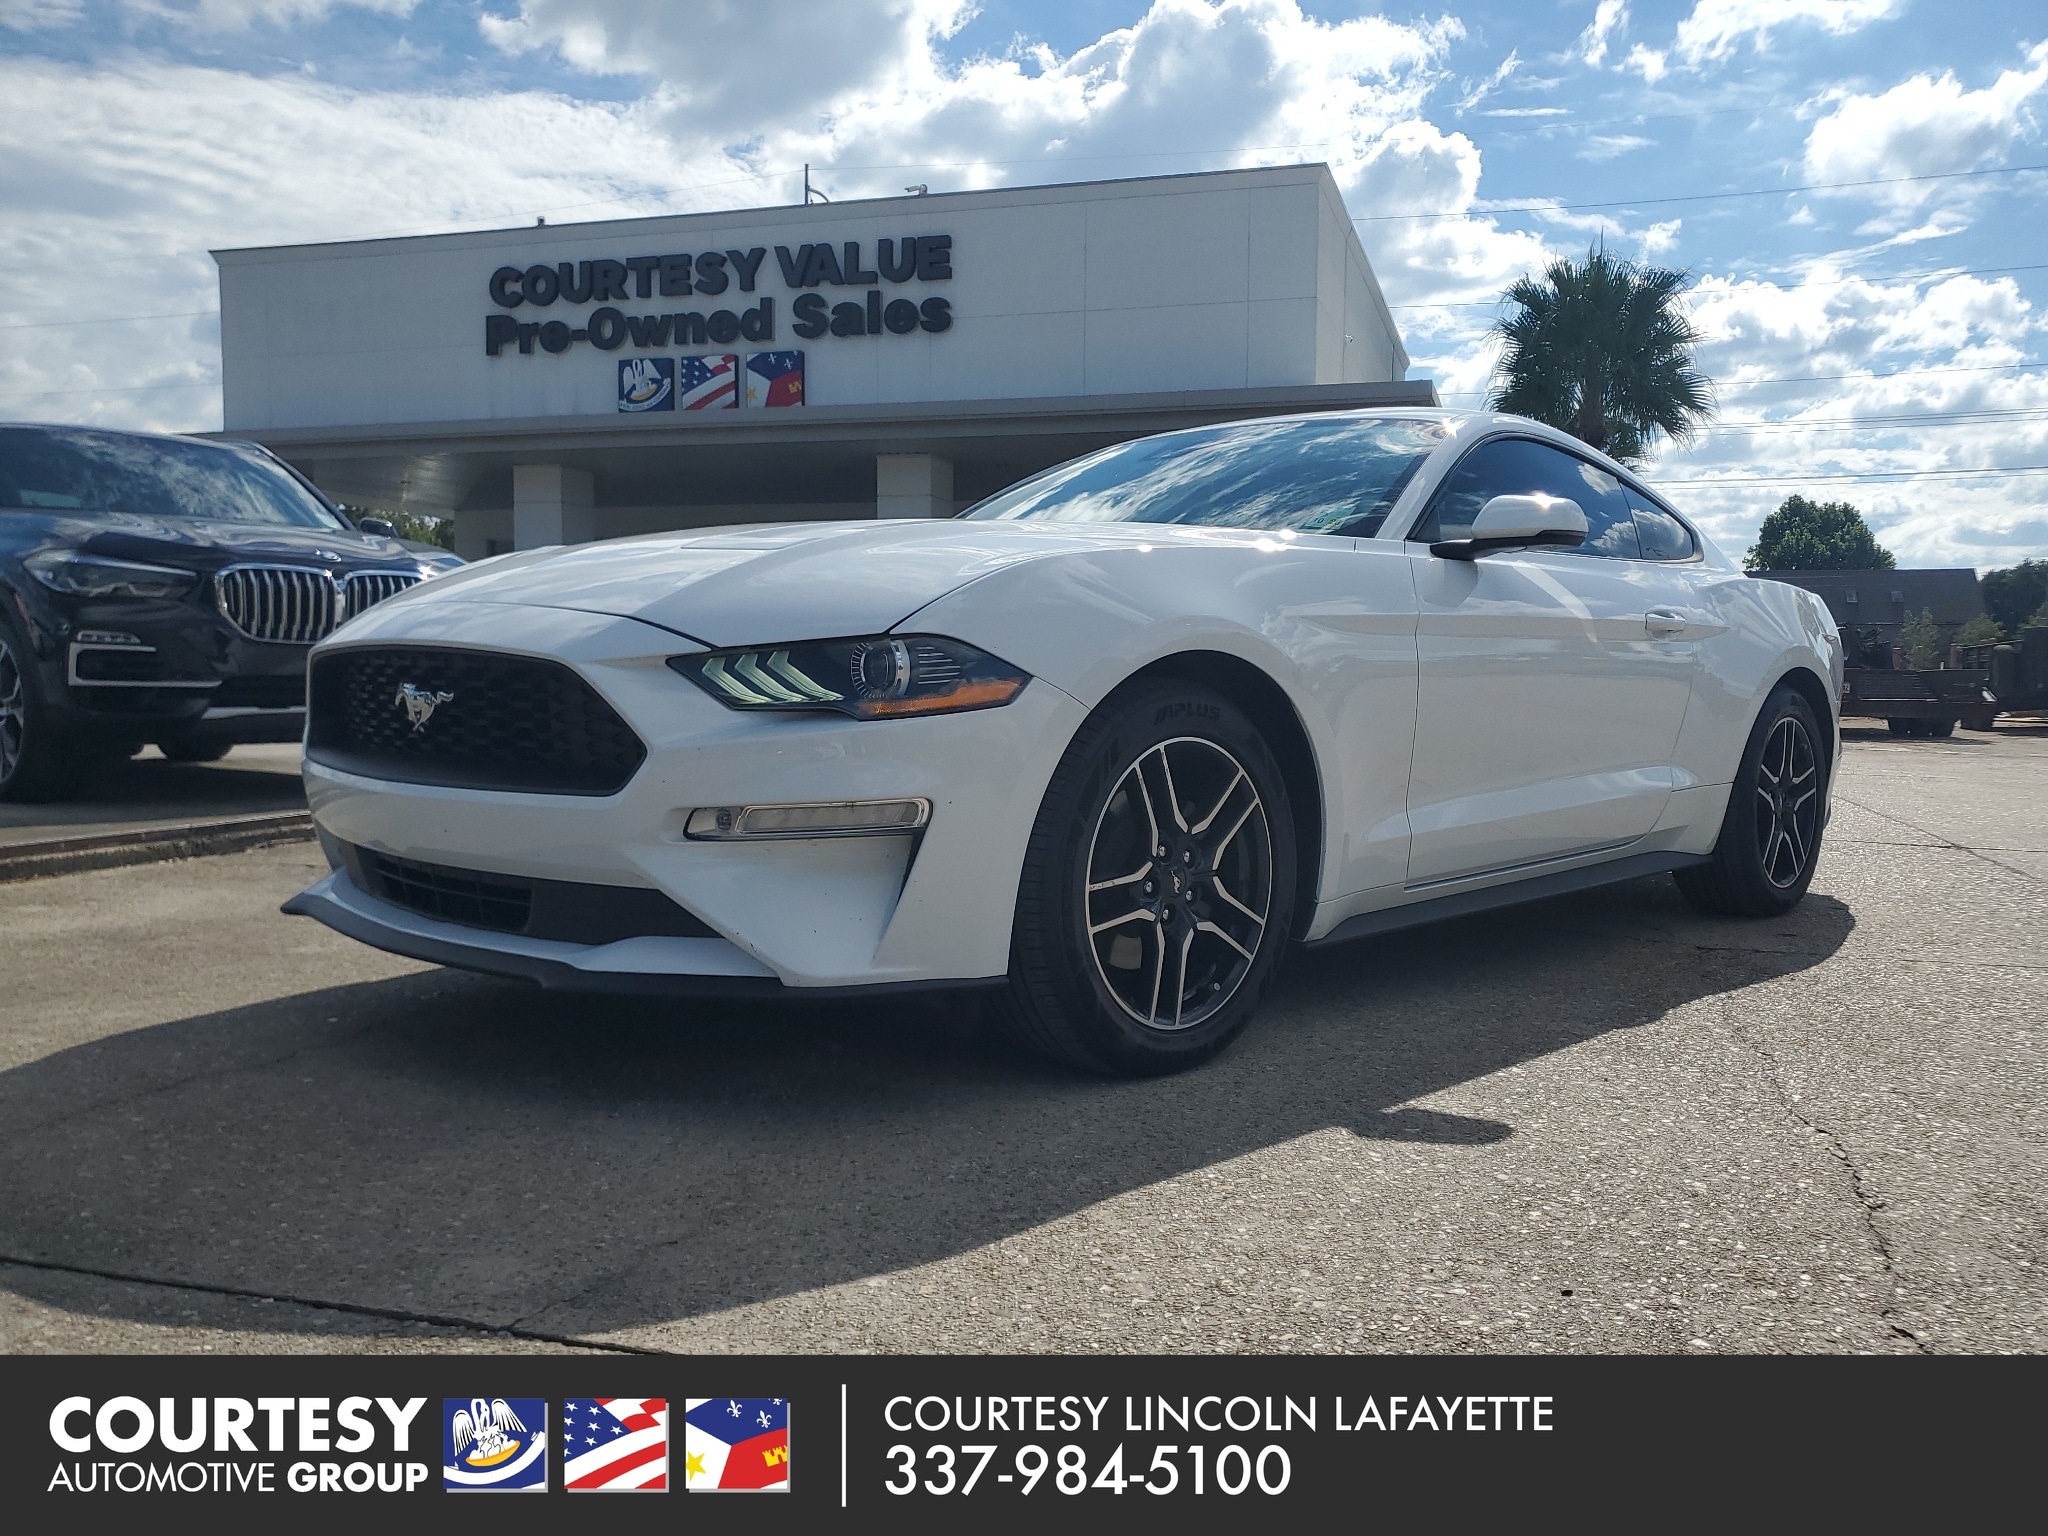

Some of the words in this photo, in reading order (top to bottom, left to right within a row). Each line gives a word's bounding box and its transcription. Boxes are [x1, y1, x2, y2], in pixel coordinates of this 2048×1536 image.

[489, 247, 767, 309] COURTESY
[774, 235, 952, 288] VALUE
[485, 297, 774, 355] Pre-Owned
[792, 290, 953, 340] Sales
